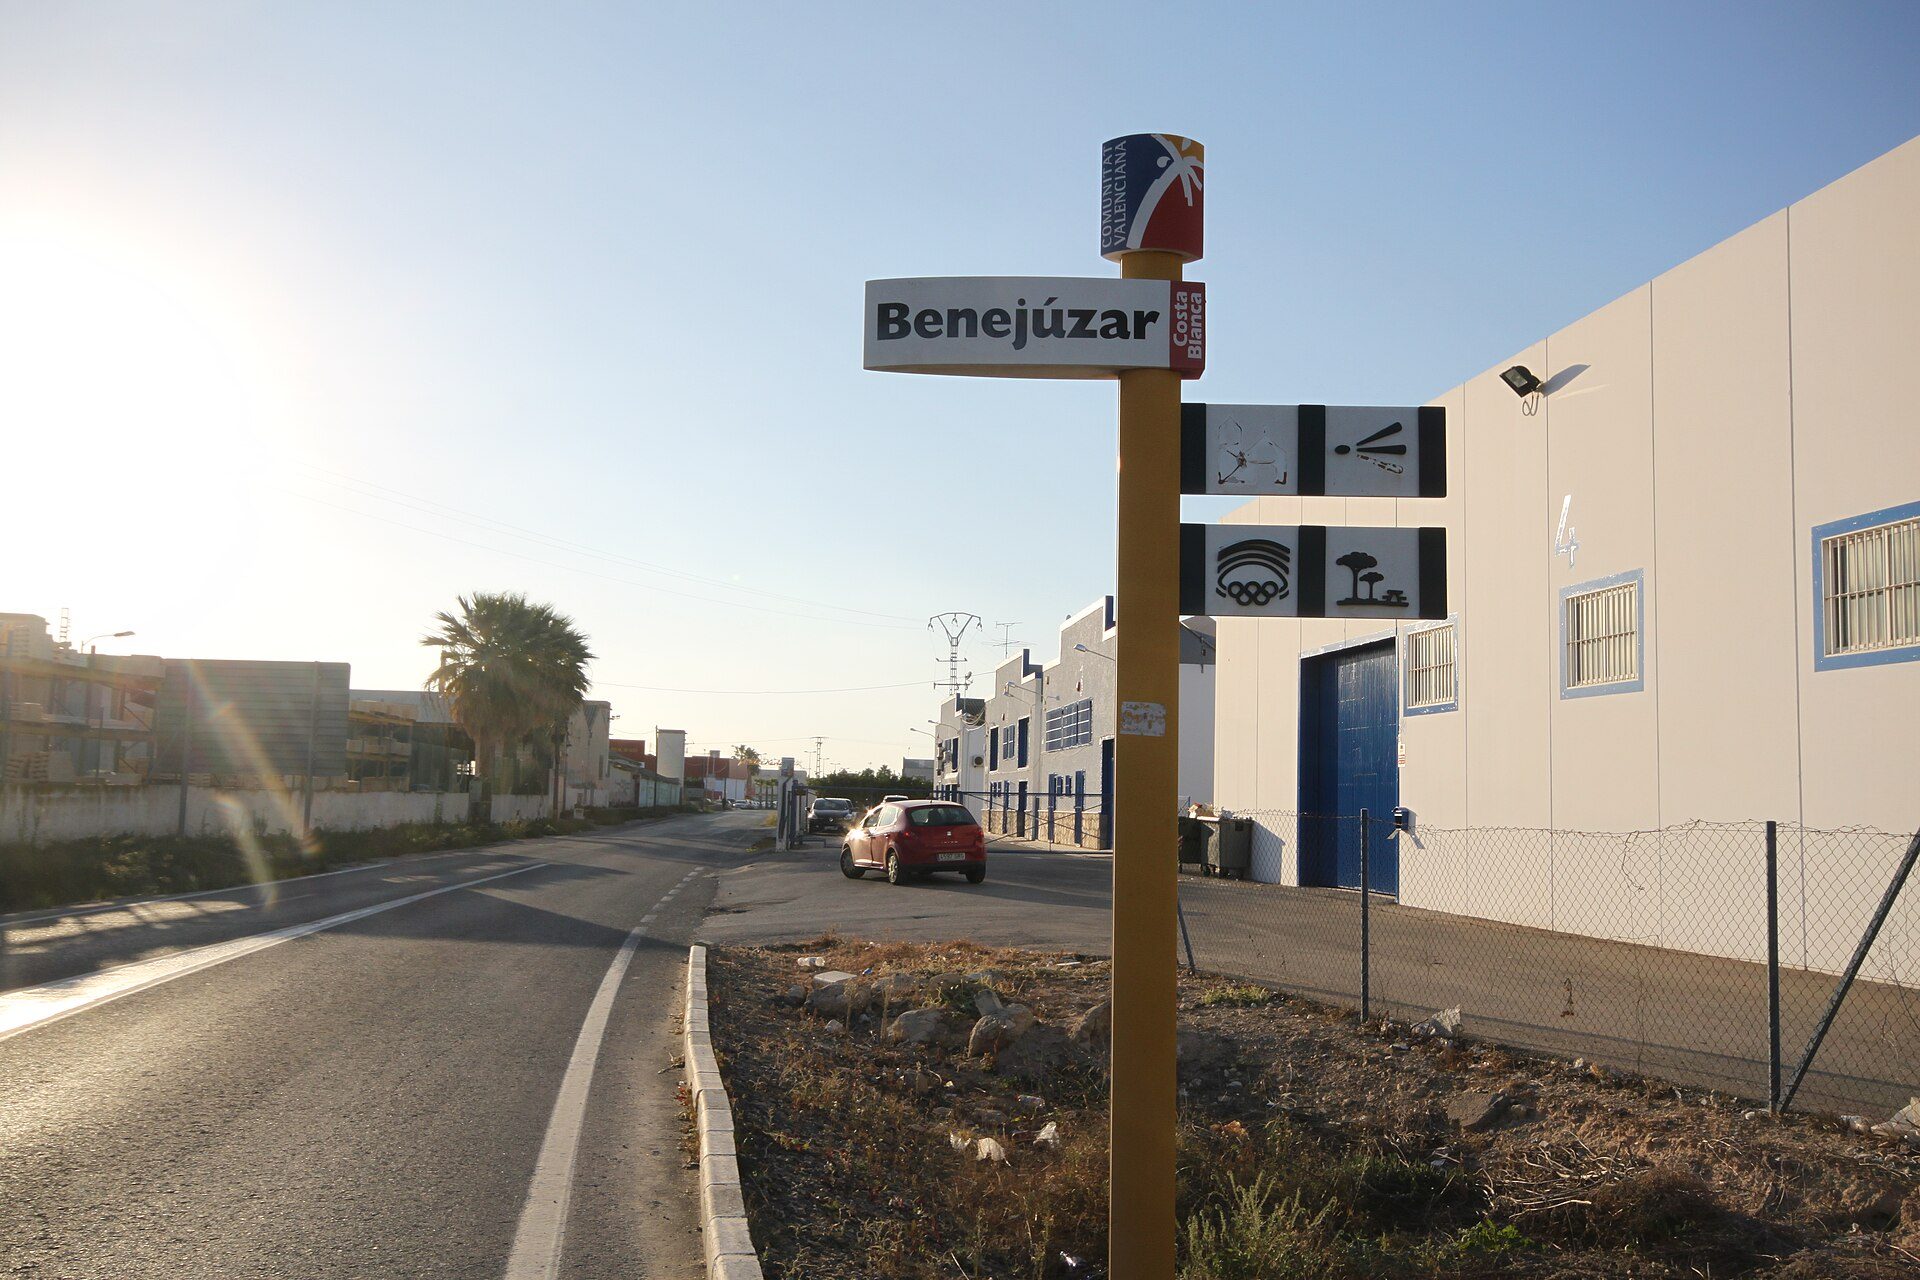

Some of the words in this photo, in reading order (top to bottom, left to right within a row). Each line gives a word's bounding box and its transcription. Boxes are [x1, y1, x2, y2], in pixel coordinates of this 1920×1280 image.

[1102, 146, 1112, 248] COMUNITAT
[1114, 140, 1126, 246] VALENCIANA
[877, 297, 1160, 350] Benejúzar
[1173, 291, 1188, 347] Costa
[1187, 292, 1202, 359] Blanca
